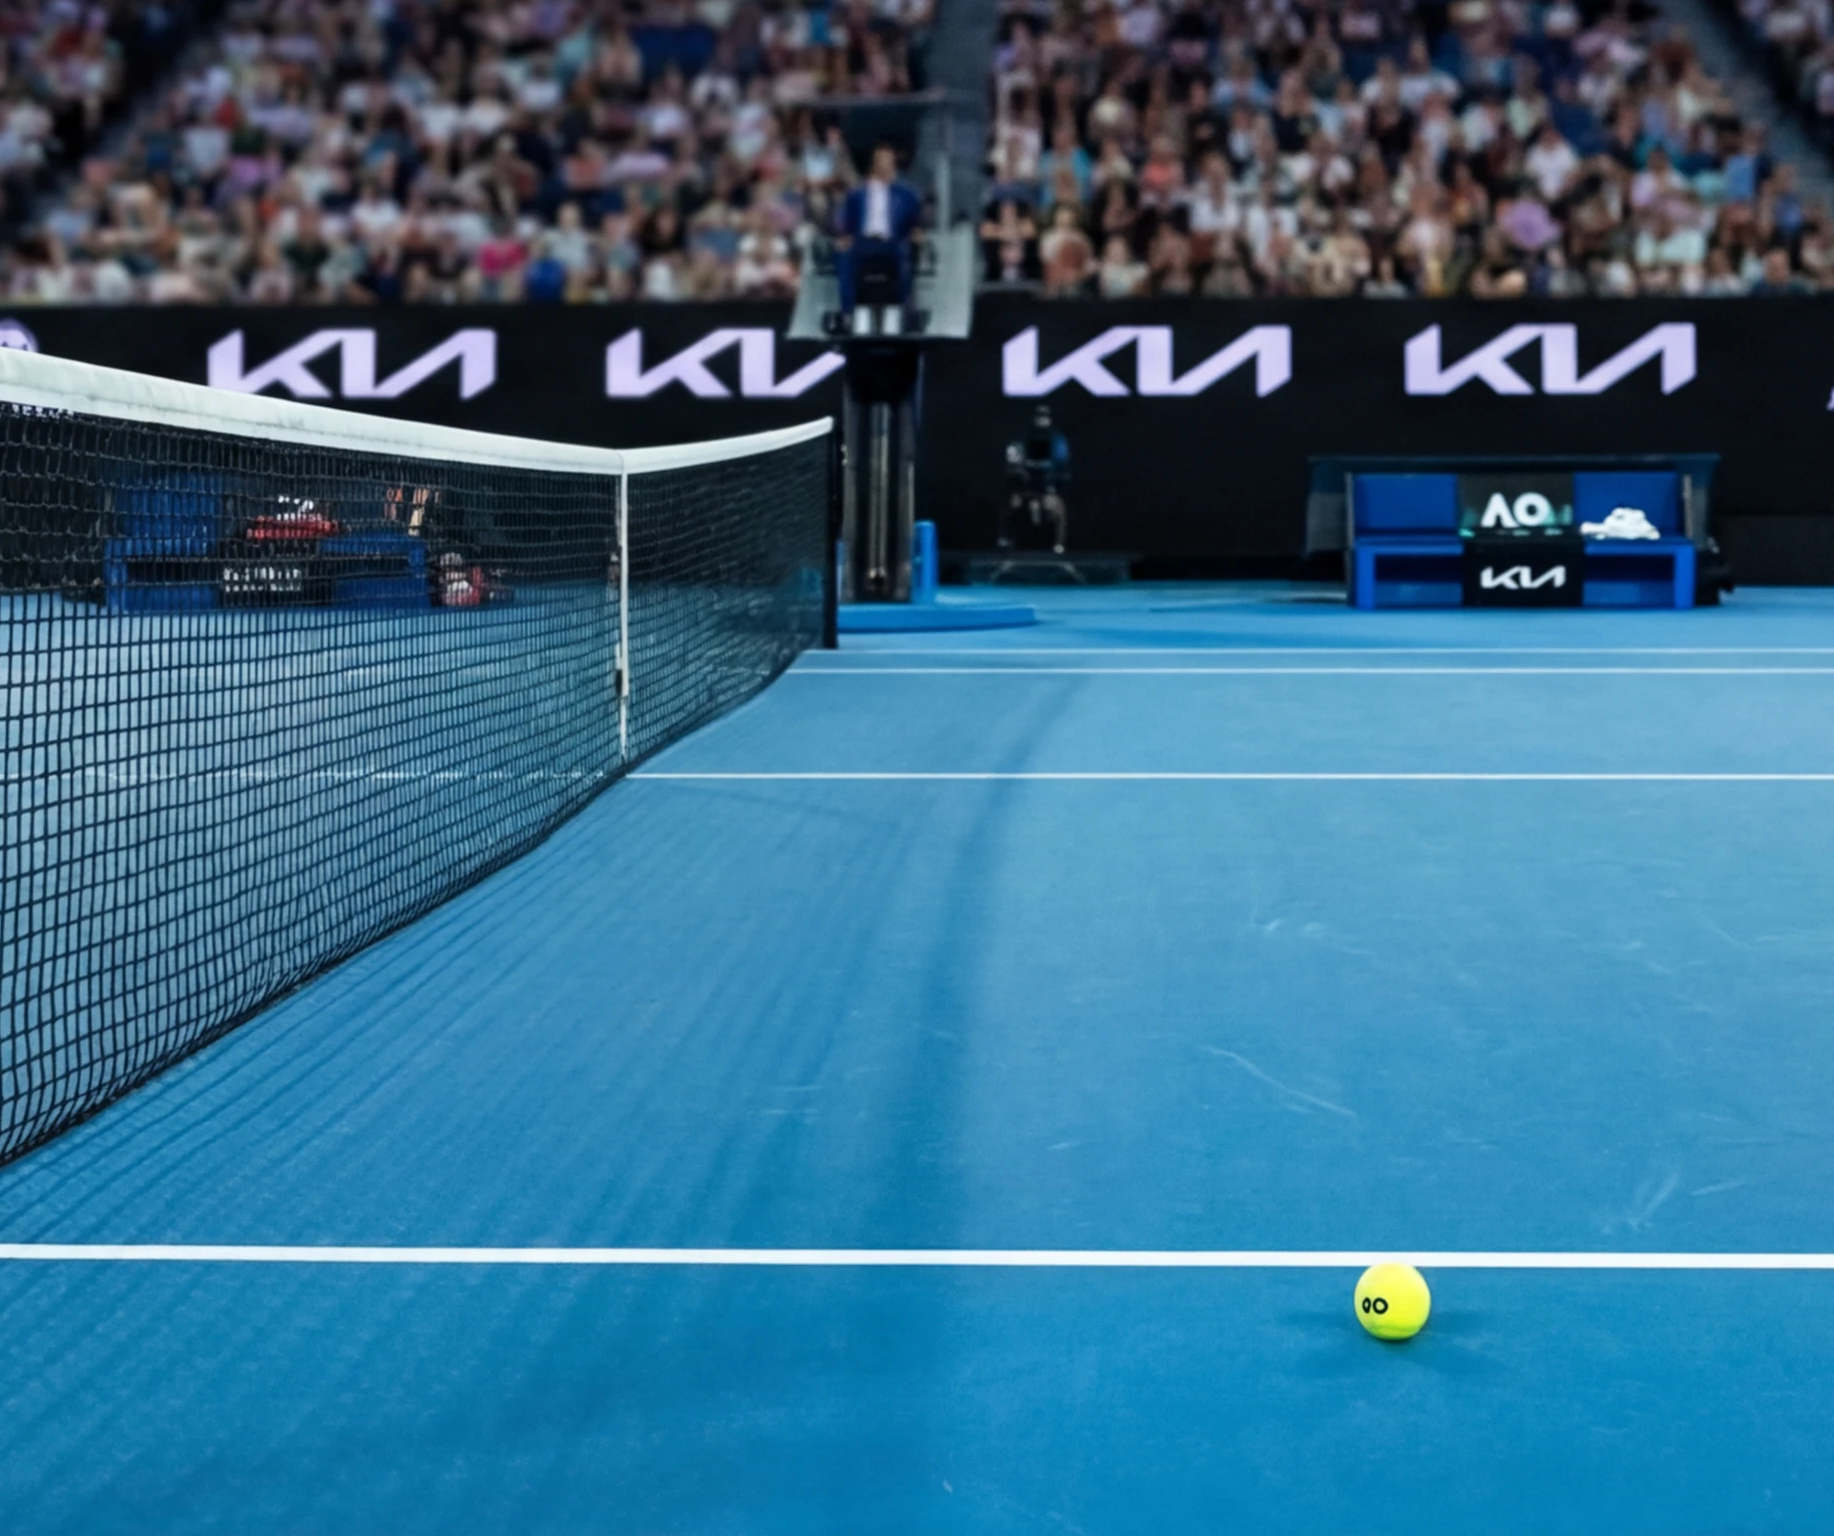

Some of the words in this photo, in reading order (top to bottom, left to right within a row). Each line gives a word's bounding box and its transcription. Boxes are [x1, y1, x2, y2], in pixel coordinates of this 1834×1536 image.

[207, 328, 497, 399] KIA
[1003, 325, 1292, 398] KIA
[1404, 323, 1697, 396] KIA
[1480, 492, 1551, 528] AO
[1480, 565, 1567, 589] KIA
